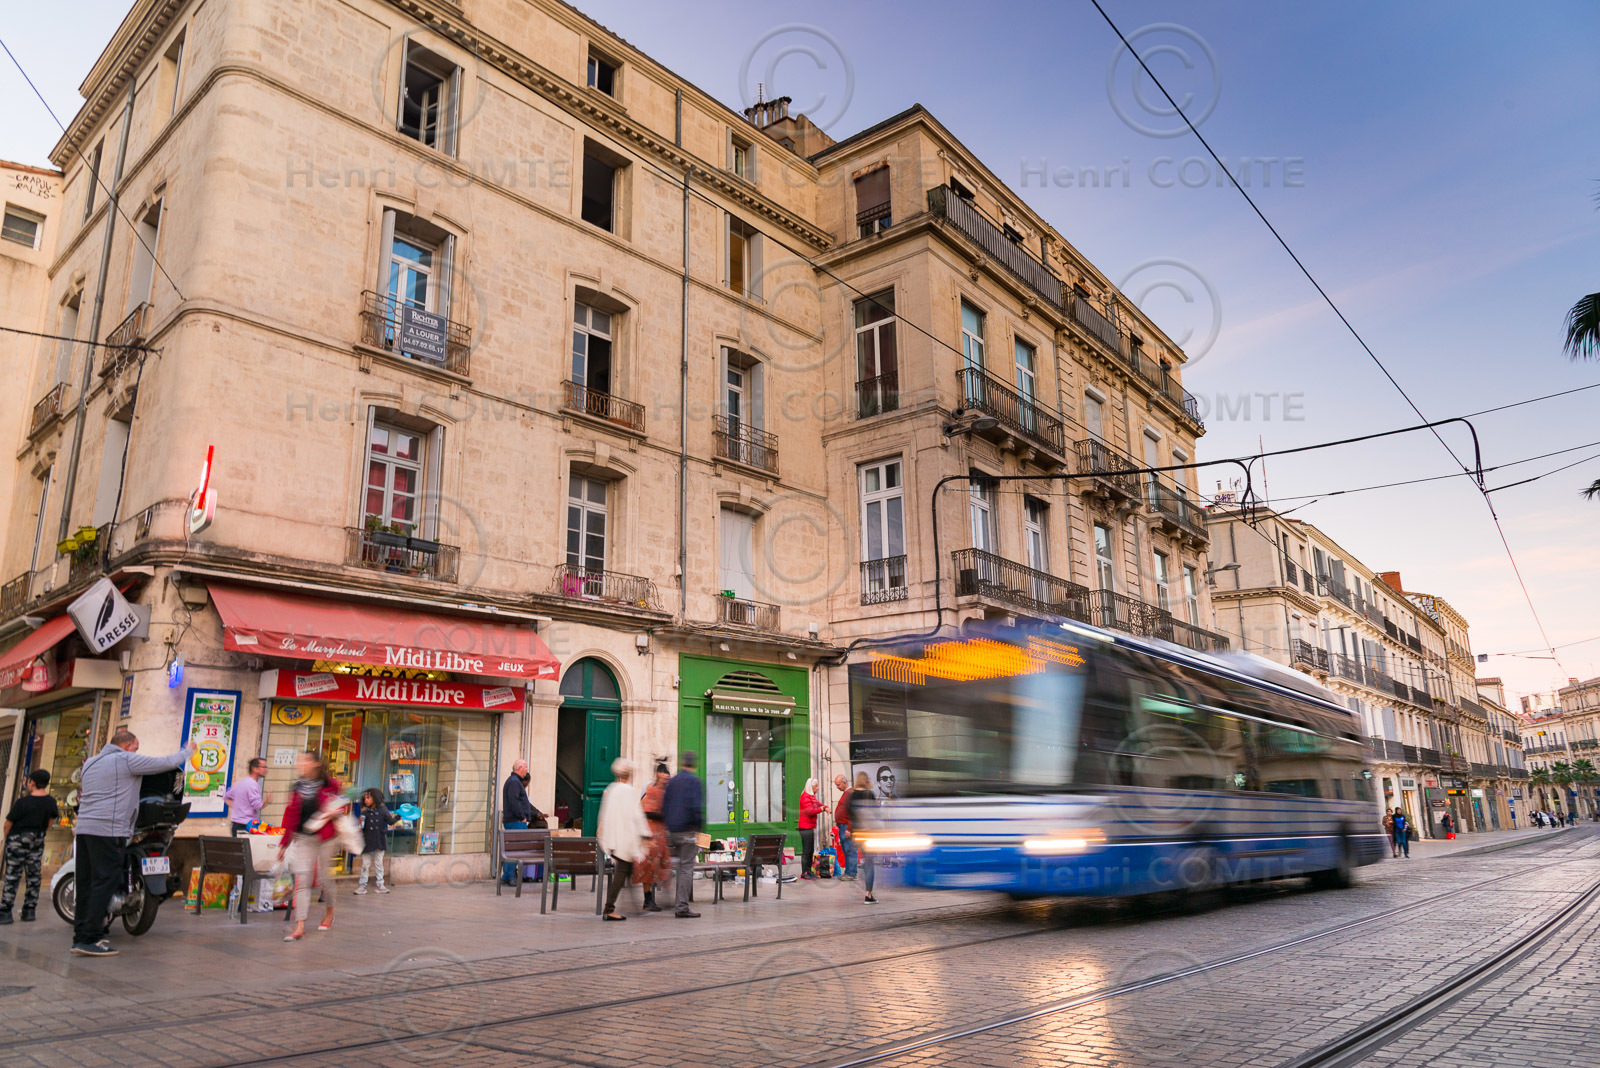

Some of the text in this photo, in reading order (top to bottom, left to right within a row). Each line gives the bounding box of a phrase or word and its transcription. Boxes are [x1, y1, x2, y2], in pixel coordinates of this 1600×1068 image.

[412, 310, 438, 327] RICHTER
[416, 329, 439, 342] LOUER
[97, 612, 136, 648] PRESSE
[301, 640, 367, 658] Maryland
[498, 662, 525, 673] JEUX
[206, 728, 217, 736] 13
[200, 748, 219, 767] 13
